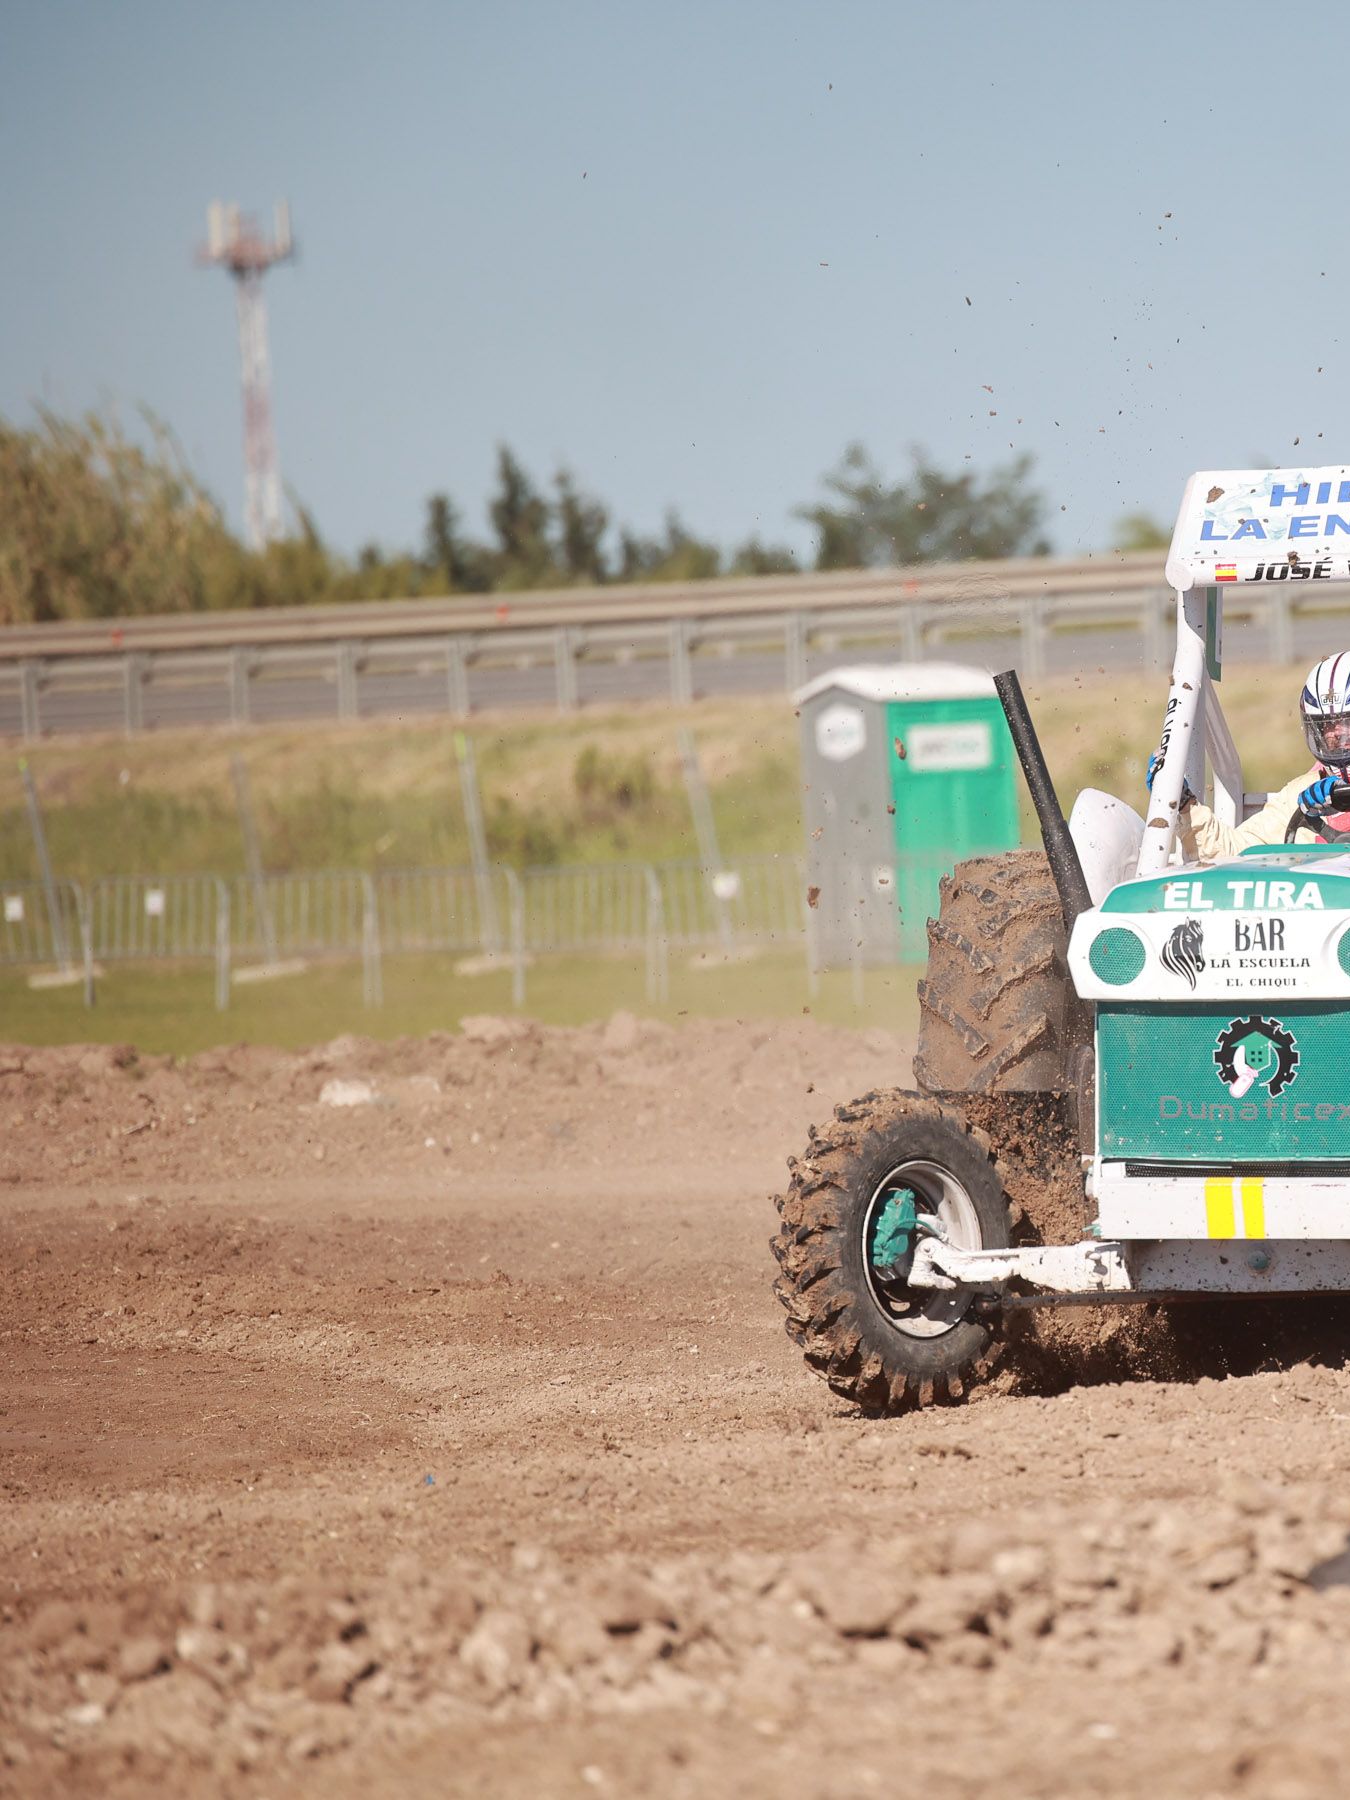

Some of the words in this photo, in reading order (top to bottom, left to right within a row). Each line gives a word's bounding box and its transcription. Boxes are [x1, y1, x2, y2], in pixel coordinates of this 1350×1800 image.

[1199, 518, 1268, 541] LA
[1245, 556, 1333, 581] JOSÉ
[1163, 881, 1214, 909] EL
[1226, 881, 1325, 909] TIRA
[1235, 918, 1285, 951] BAR
[1210, 958, 1231, 969] LA
[1239, 957, 1311, 969] ESCUELA
[1226, 978, 1243, 987] EL
[1249, 977, 1297, 987] CHIQUI
